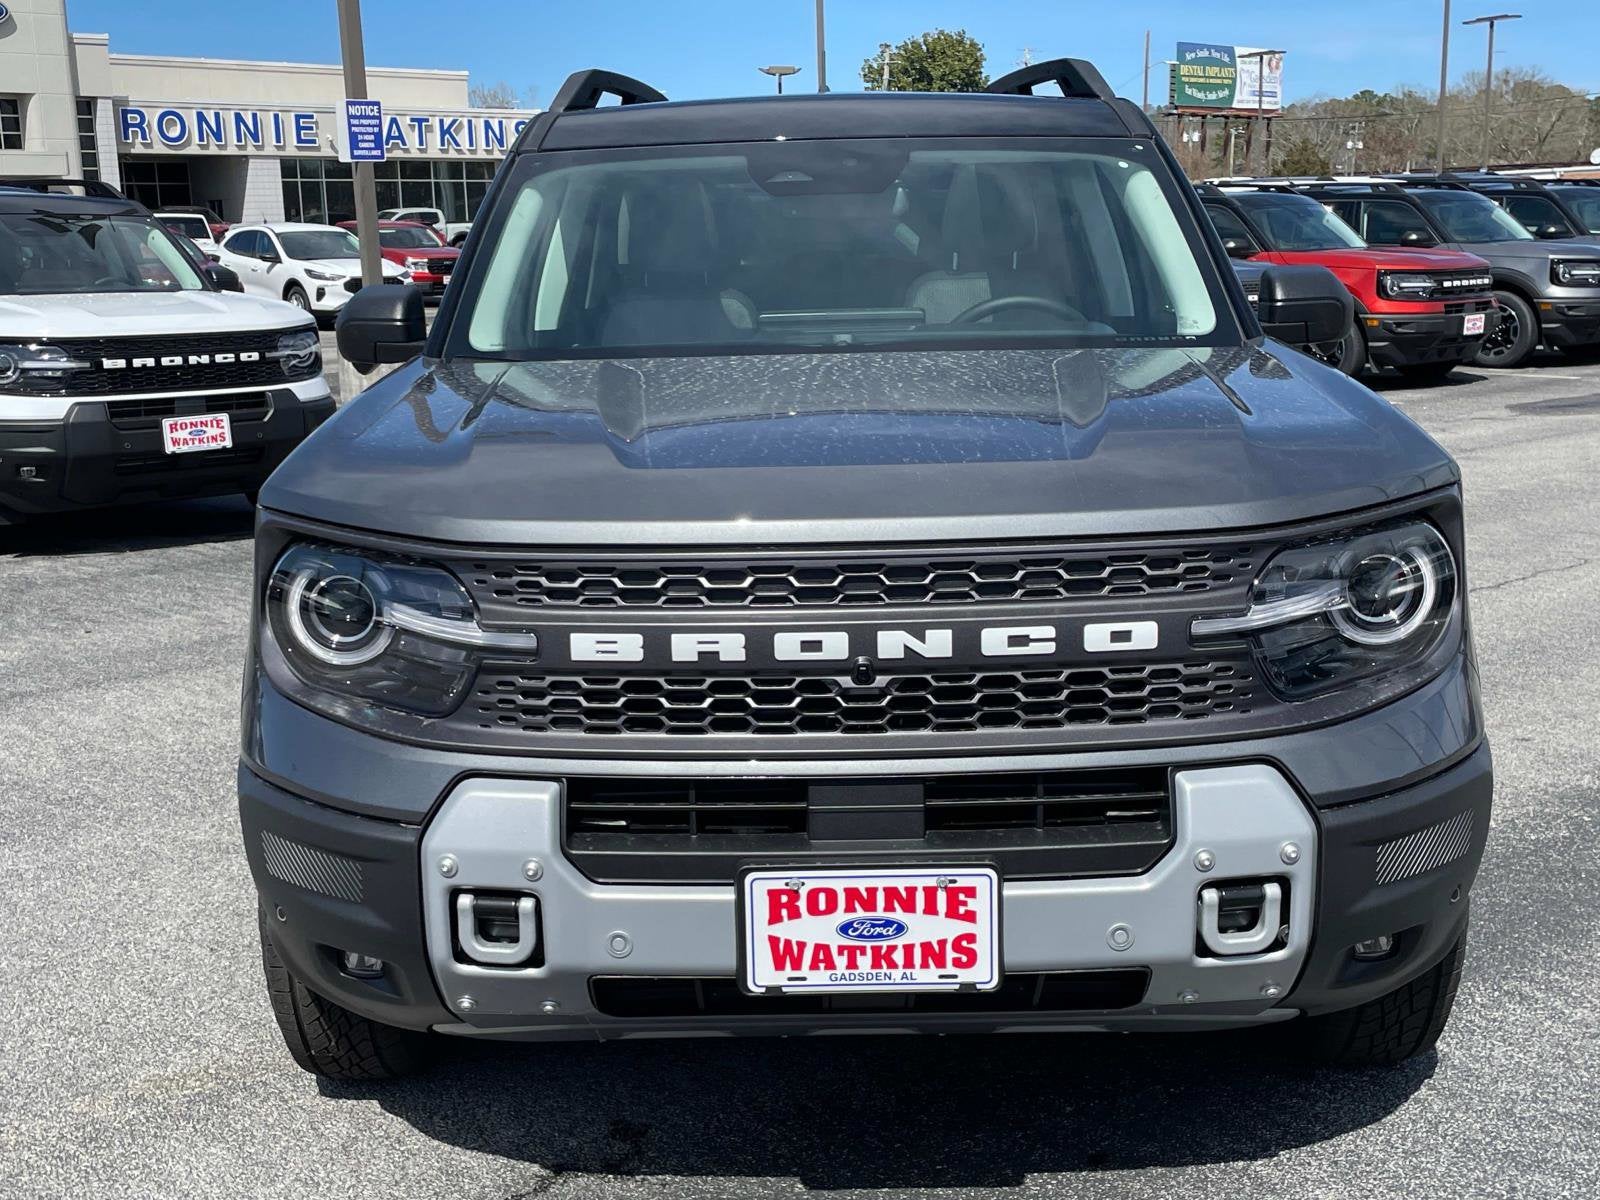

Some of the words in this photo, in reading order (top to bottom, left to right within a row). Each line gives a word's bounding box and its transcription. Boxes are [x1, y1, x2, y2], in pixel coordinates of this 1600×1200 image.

[1180, 64, 1204, 76] DENTAL
[1205, 66, 1236, 78] IMPLANTS
[348, 105, 380, 116] NOTICE
[119, 107, 319, 147] RONNIE
[383, 115, 529, 150] ATKIN
[1443, 278, 1489, 287] BRONCO
[102, 351, 260, 369] BRONCO
[169, 418, 225, 433] RONNIE
[170, 432, 226, 447] WATKINS
[569, 620, 1159, 662] BRONCO
[767, 886, 978, 926] RONNIE
[846, 917, 900, 940] Ford
[767, 932, 979, 972] WATKINS
[829, 972, 897, 984] GADSDEN,
[900, 971, 918, 981] AL
